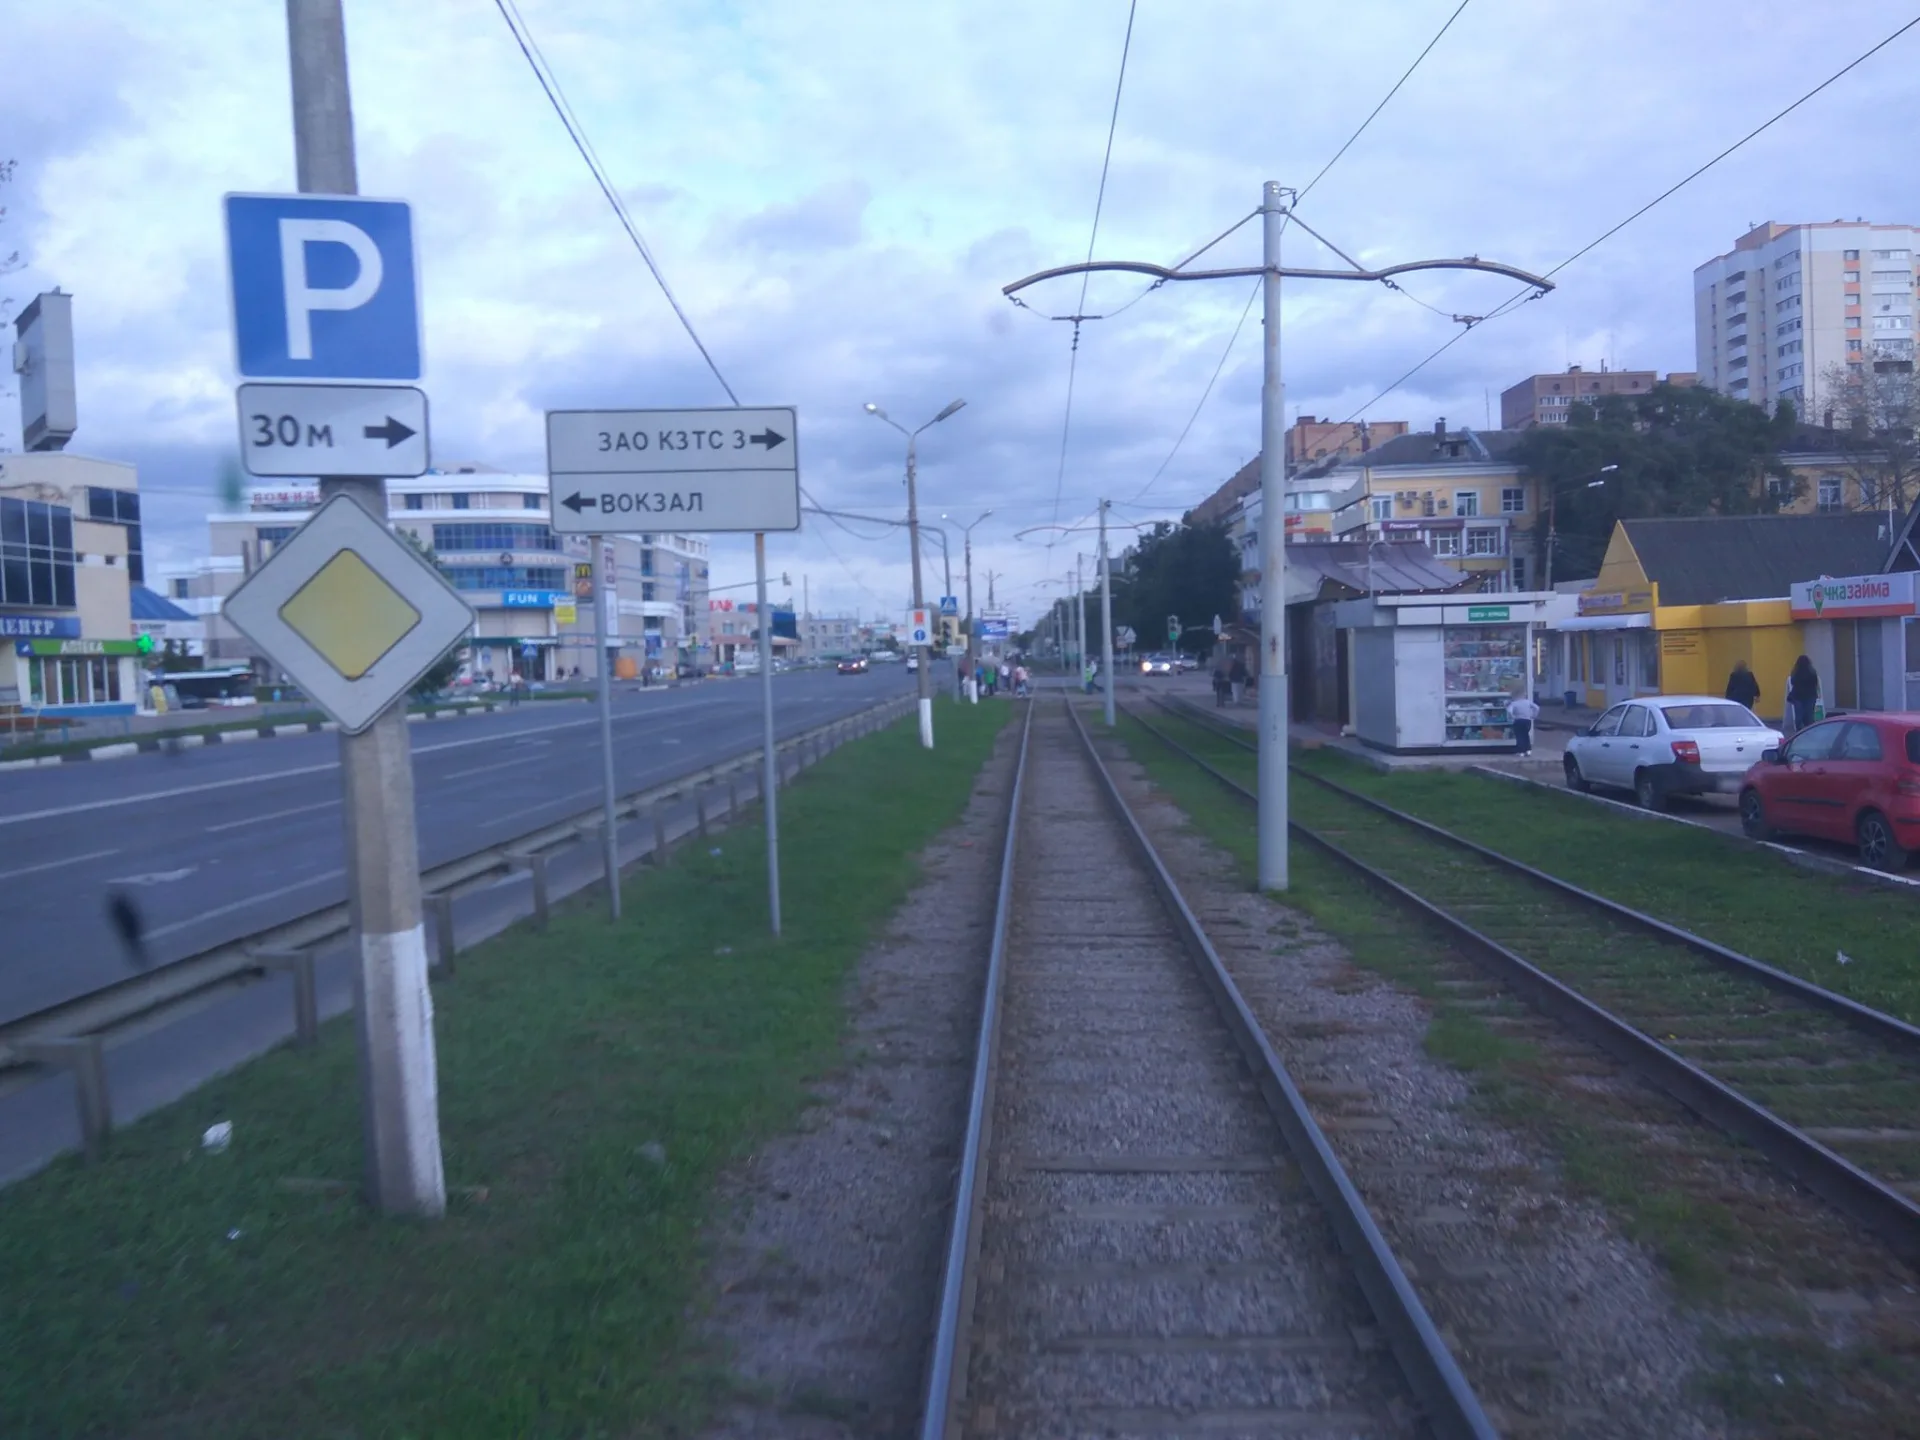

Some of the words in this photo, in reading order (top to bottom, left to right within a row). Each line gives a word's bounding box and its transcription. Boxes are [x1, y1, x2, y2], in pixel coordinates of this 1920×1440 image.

[278, 217, 384, 360] P
[251, 414, 300, 448] 30
[598, 431, 650, 452] ЗАО
[659, 430, 724, 451] КЗТС
[600, 492, 704, 514] ВОКЗАЛ
[507, 593, 539, 605] FUN
[60, 640, 105, 654] АПТЕКА
